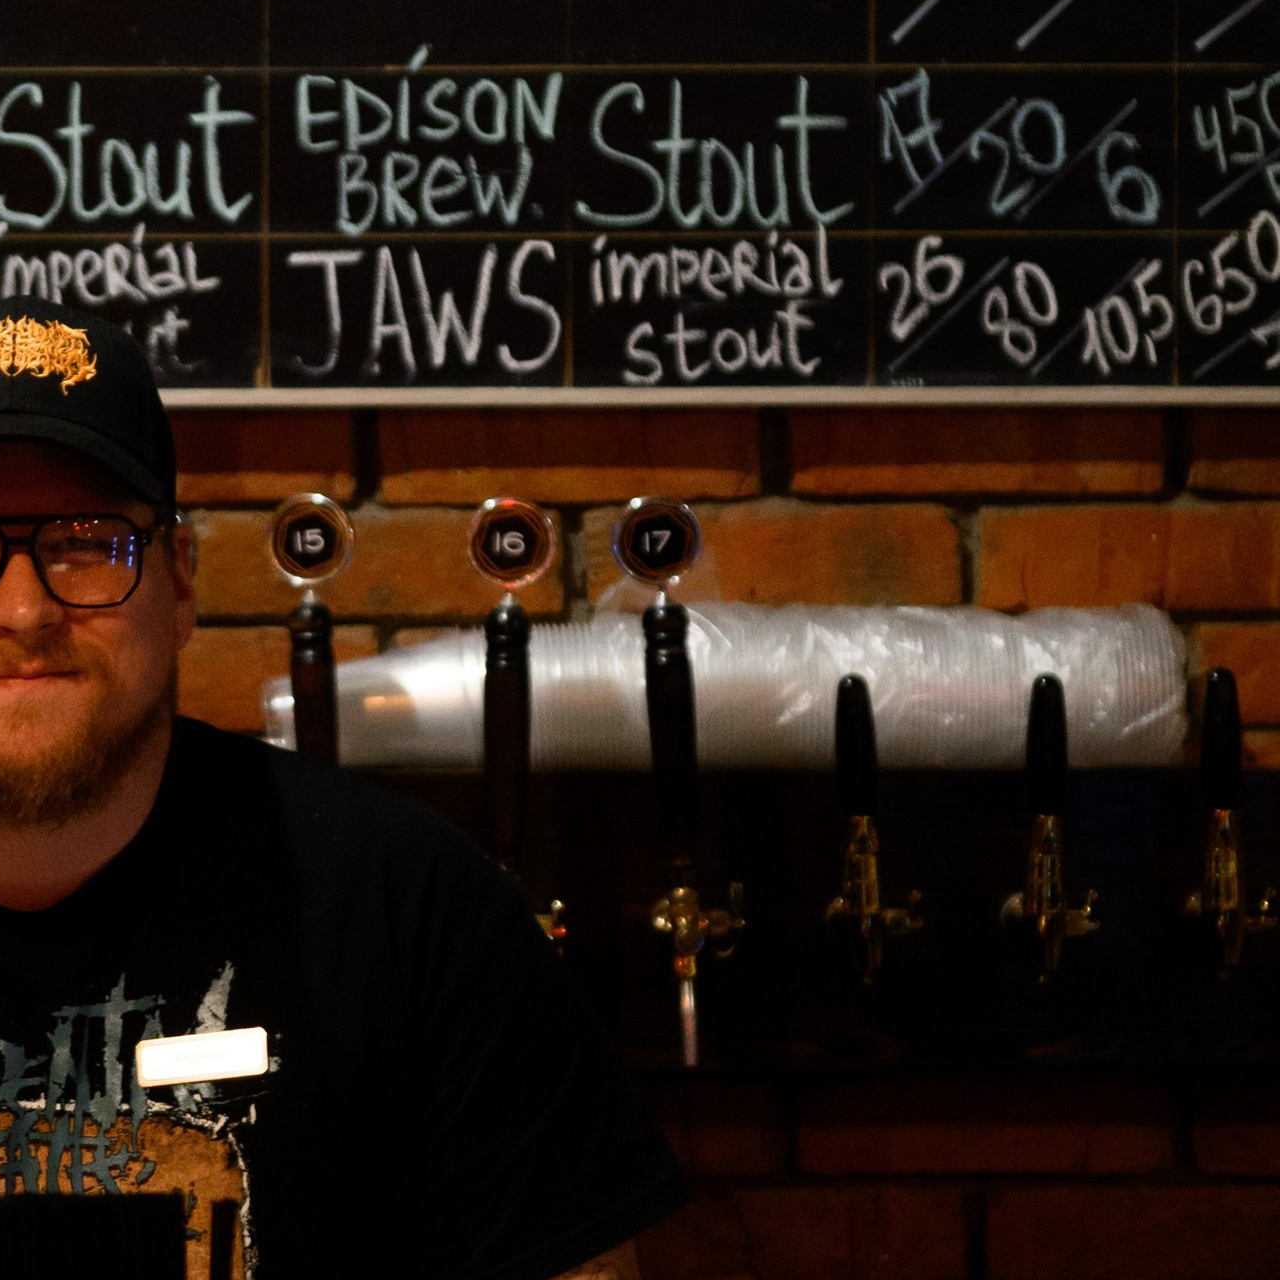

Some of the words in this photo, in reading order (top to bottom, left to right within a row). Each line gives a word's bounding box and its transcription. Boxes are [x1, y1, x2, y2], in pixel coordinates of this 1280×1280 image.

[576, 77, 855, 227] Stout
[970, 98, 1067, 216] 20
[1097, 131, 1161, 223] 6
[286, 240, 562, 376] JAWS
[623, 301, 819, 385] stout
[879, 236, 964, 341] 26
[982, 261, 1058, 365] 80
[293, 528, 326, 553] 15
[492, 530, 526, 556] 16
[640, 530, 674, 554] 17
